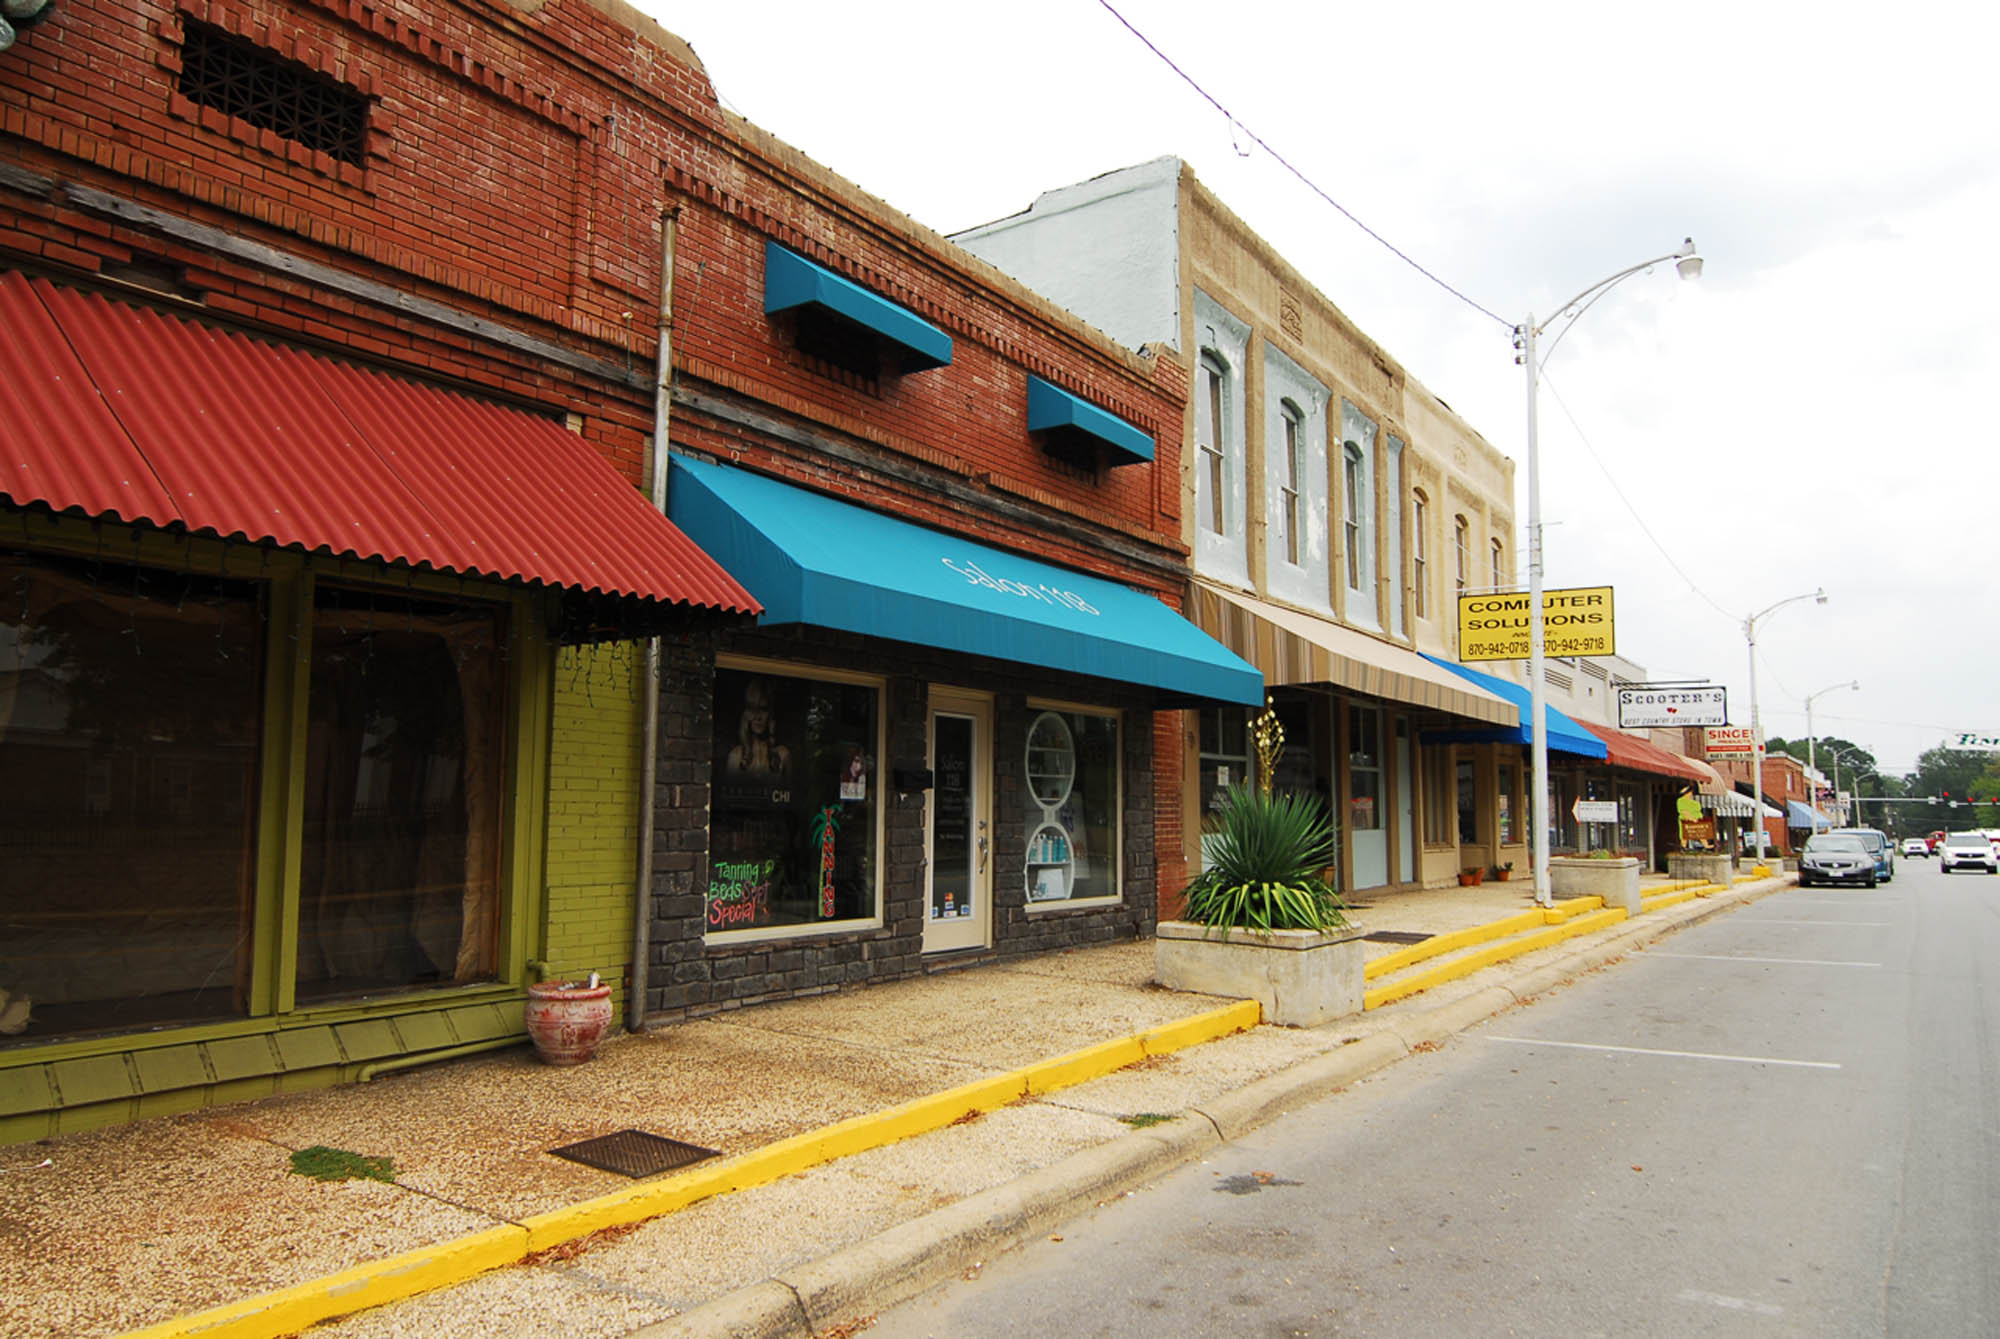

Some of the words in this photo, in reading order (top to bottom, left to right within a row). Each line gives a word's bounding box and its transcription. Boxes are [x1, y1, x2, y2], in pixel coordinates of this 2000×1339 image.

[941, 557, 1054, 605] Salon
[1468, 613, 1603, 631] SOLUIONS
[1468, 640, 1529, 656] 870-942-0718
[1621, 692, 1723, 705] SCOOTER'S
[772, 790, 791, 803] CHI
[714, 860, 760, 886] Tanning
[823, 808, 836, 918] TANNING
[709, 880, 743, 901] Beds
[709, 896, 757, 928] Special
